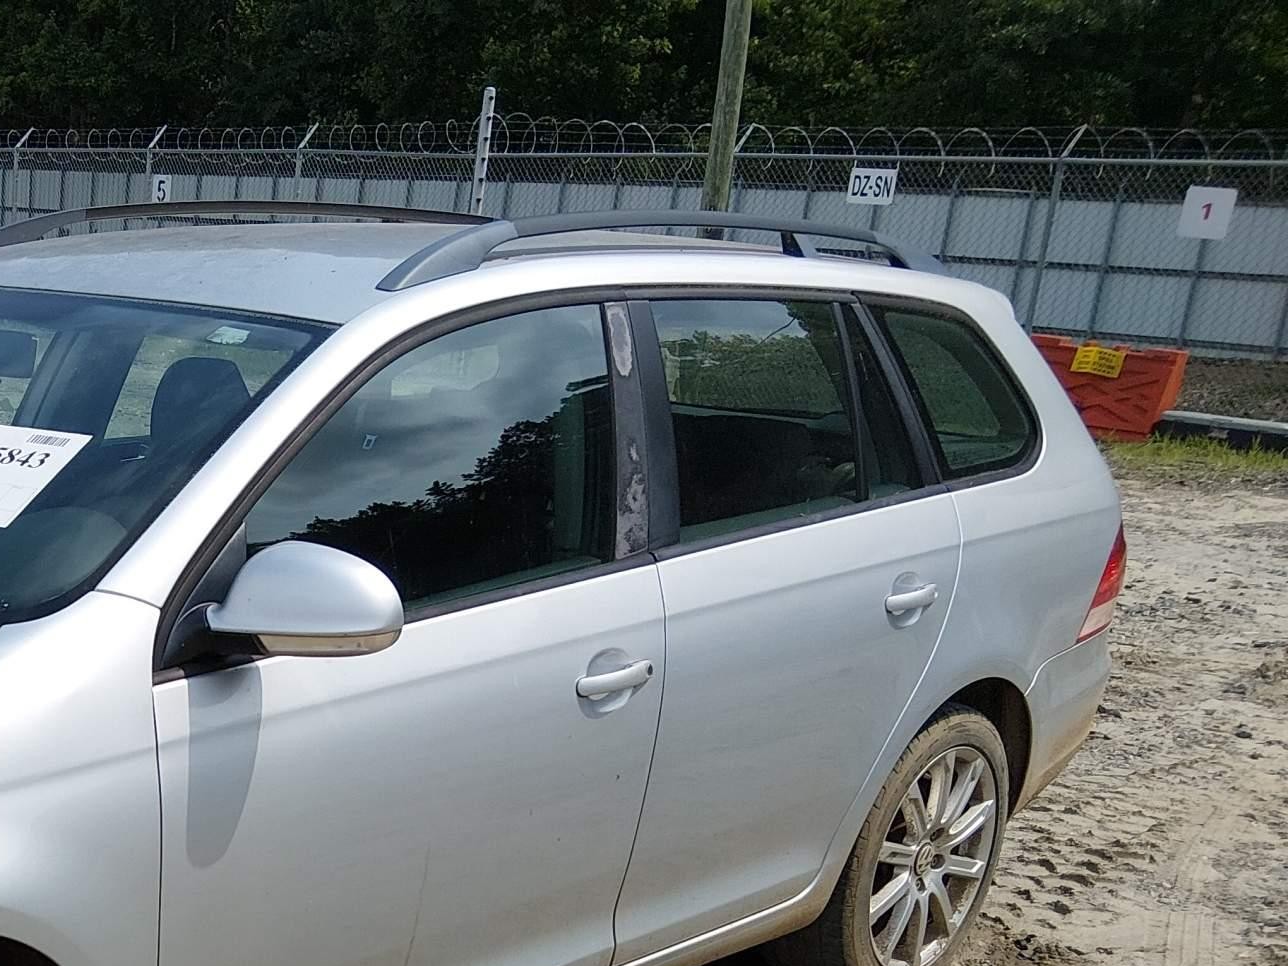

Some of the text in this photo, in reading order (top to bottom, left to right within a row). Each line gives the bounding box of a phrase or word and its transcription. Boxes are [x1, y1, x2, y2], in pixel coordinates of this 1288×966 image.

[157, 179, 166, 202] 5
[851, 175, 893, 199] DZ-SN
[1202, 203, 1212, 220] 1
